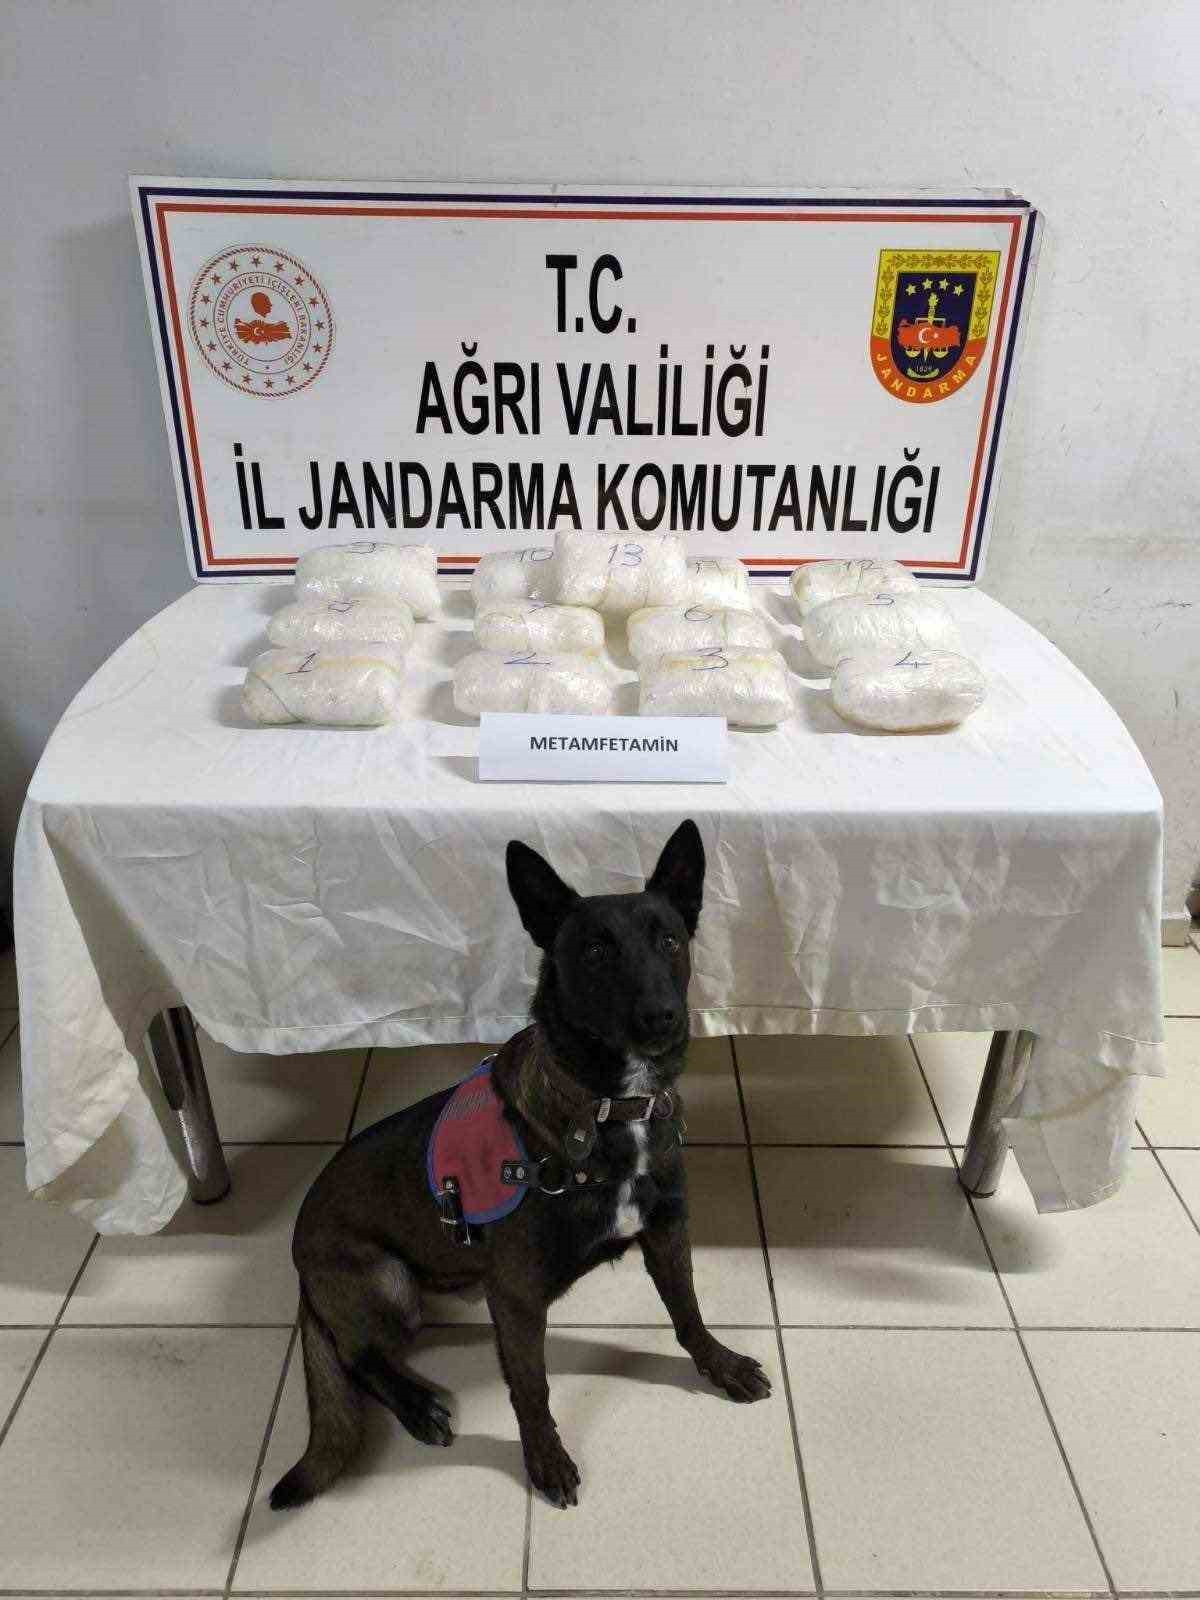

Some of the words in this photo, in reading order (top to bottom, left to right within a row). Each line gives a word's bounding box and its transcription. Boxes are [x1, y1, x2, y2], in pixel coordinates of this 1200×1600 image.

[545, 253, 636, 335] T.C.
[415, 341, 541, 436] AĞRI
[556, 343, 770, 438] VALİLİĞİ
[876, 353, 976, 398] JANDARMA
[233, 442, 286, 530] İL
[298, 461, 583, 530] JANDARMA
[597, 447, 941, 534] KOMUTANLIĞI
[608, 543, 645, 567] 13
[690, 647, 729, 671] 3
[529, 735, 679, 753] METAMFETAMİN
